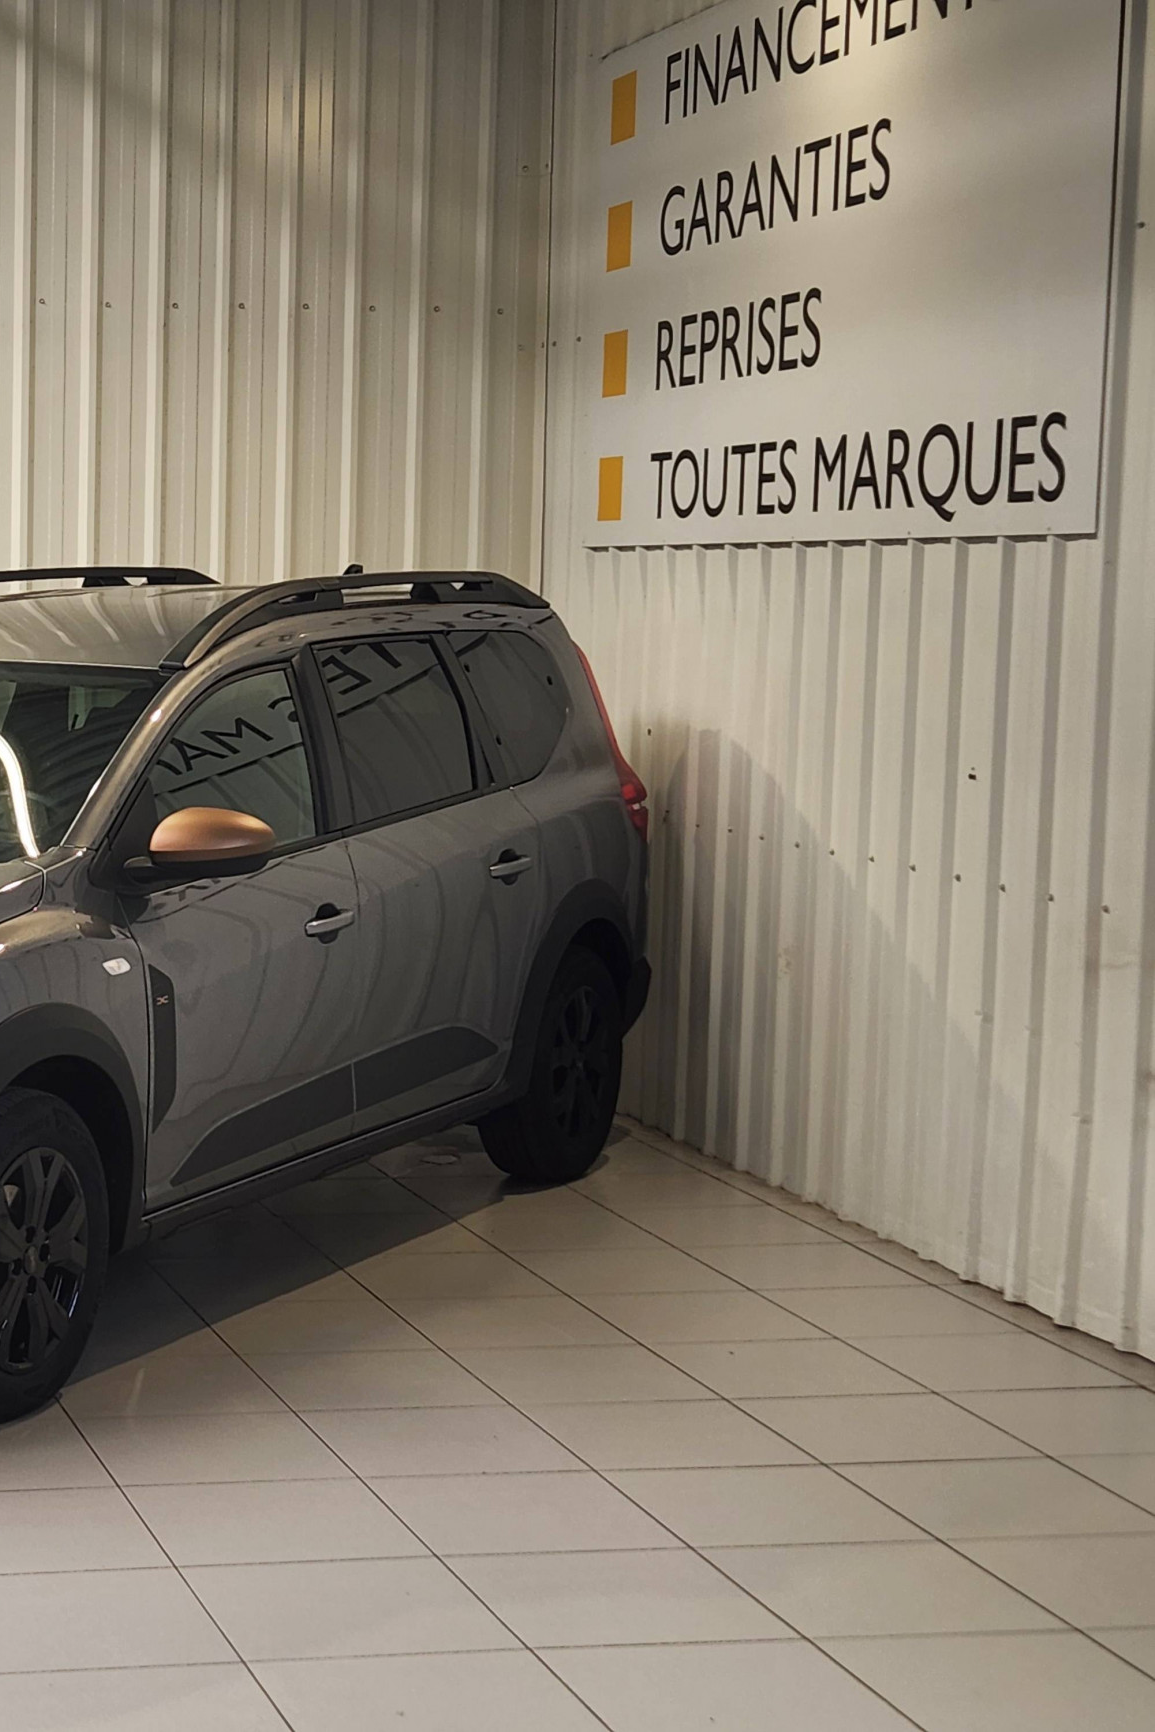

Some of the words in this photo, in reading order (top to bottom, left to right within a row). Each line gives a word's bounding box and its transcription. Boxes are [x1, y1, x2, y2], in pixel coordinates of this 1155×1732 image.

[664, 0, 973, 125] FINANCEME
[659, 118, 892, 256] GARANTIES
[655, 287, 822, 391] REPRISES
[650, 440, 798, 519] TOUTES
[812, 412, 1068, 523] MARQUES
